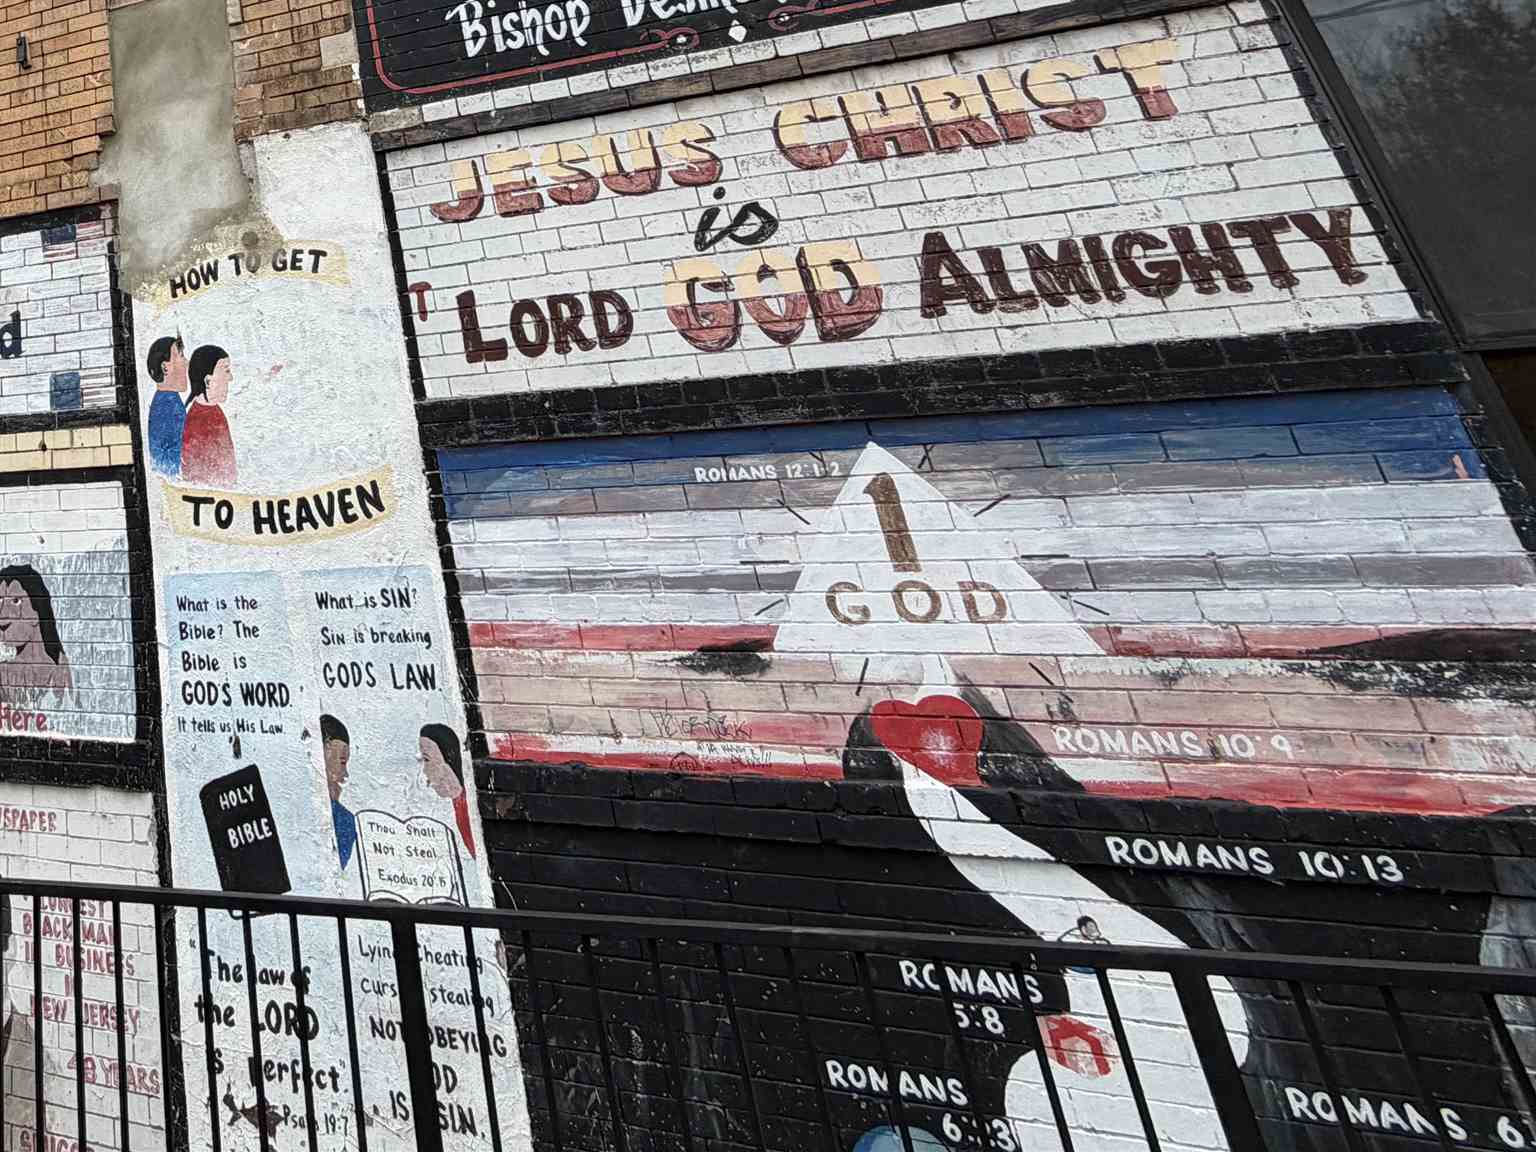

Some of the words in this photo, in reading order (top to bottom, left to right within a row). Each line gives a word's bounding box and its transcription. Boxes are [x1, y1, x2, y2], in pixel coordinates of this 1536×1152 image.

[428, 119, 723, 223] JESUS
[772, 37, 1180, 170] CHRIST
[695, 187, 779, 251] is
[170, 258, 219, 299] HOW
[228, 253, 262, 274] TO
[272, 249, 327, 274] GET
[464, 285, 634, 363] LORD
[665, 242, 885, 352] GOD
[919, 207, 1367, 320] ALMIGHTY
[693, 465, 777, 483] ROMANS
[182, 495, 234, 529] TO
[253, 480, 386, 535] HEAVEN
[863, 472, 921, 572] 1
[176, 595, 209, 612] What
[216, 597, 228, 610] is
[235, 595, 258, 610] the
[316, 590, 354, 610] What
[364, 592, 377, 607] is
[381, 587, 417, 609] SIN?
[825, 580, 1008, 624] GOD
[179, 620, 224, 641] Bible?
[233, 620, 260, 638] The
[354, 631, 364, 643] is
[371, 627, 431, 649] breaking
[181, 652, 220, 673] Bible
[234, 653, 247, 669] is
[391, 663, 442, 691] LAW.
[240, 682, 292, 708] WORD.
[177, 717, 188, 733] It
[192, 718, 215, 733] tells
[220, 722, 231, 733] us
[236, 721, 256, 733] His
[1053, 727, 1204, 757] ROMANS
[219, 785, 255, 810] HOLY
[227, 817, 273, 849] BIBLE
[368, 821, 396, 835] Thou
[406, 822, 436, 838] Shalt
[406, 845, 438, 857] Steal
[1104, 836, 1275, 875] ROMANS
[1298, 850, 1405, 882] 10:13
[378, 869, 418, 886] Exodus
[389, 1090, 410, 1120] IS
